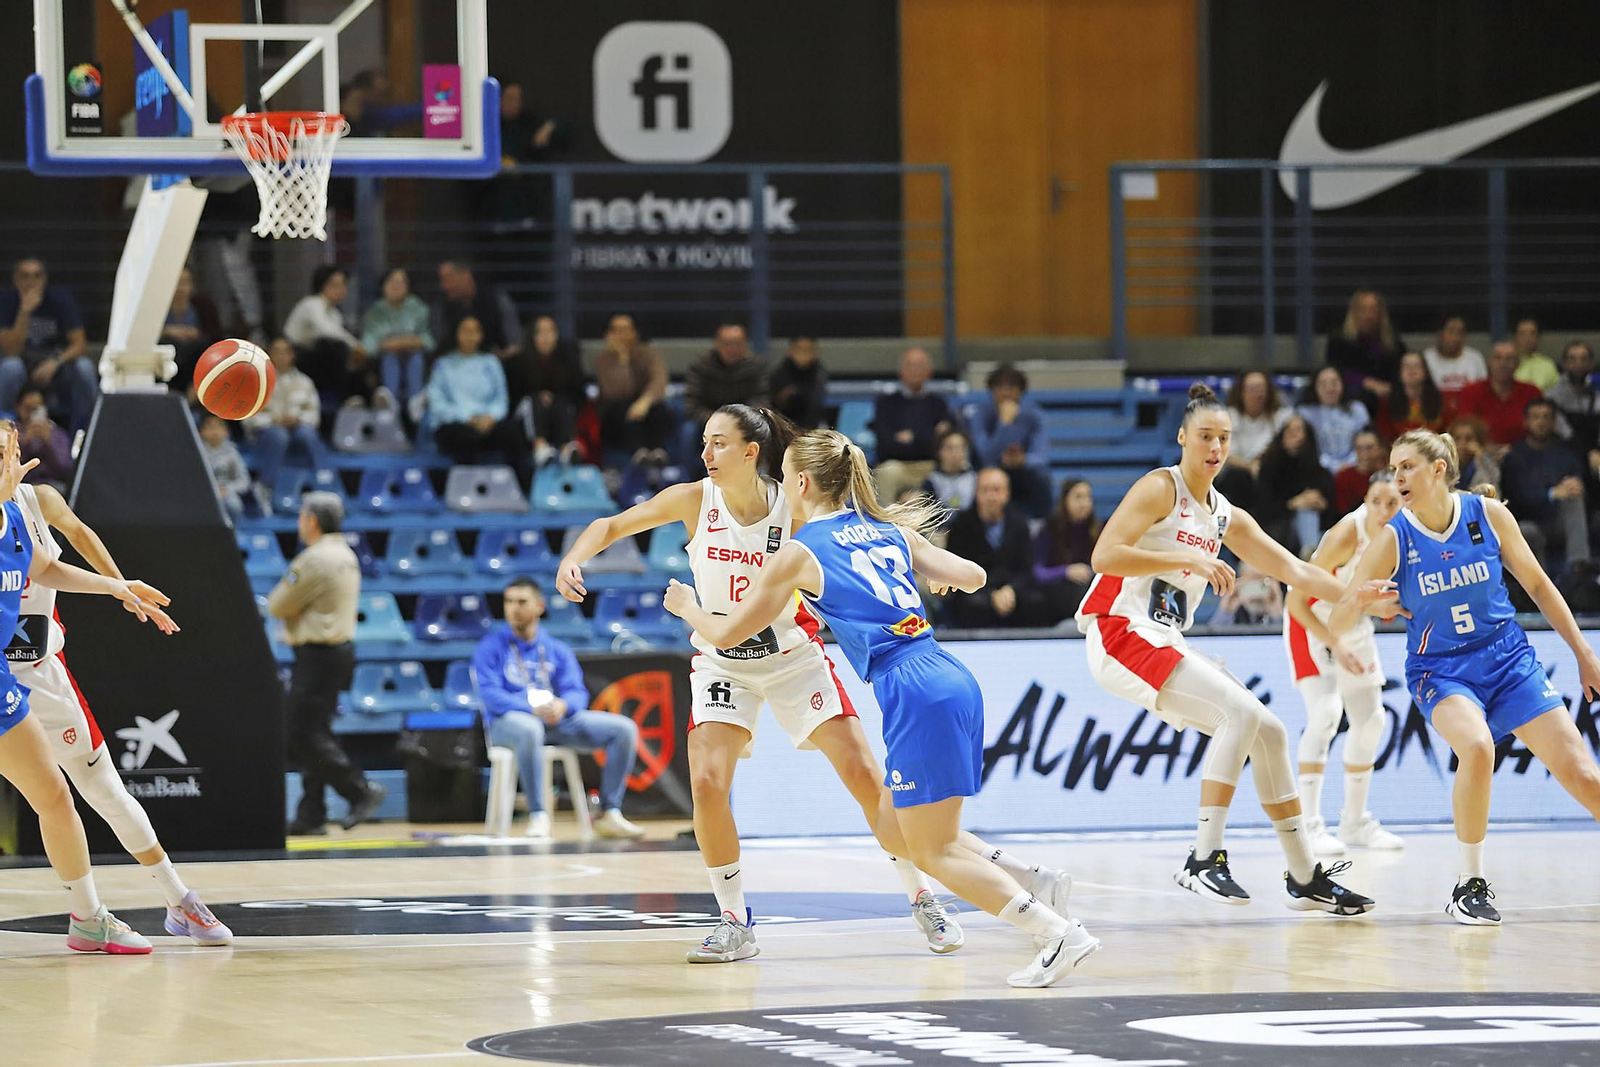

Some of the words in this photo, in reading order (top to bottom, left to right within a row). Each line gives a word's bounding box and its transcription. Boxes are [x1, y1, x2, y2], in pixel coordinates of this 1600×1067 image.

[707, 546, 765, 568] ESPAÑ
[729, 574, 751, 602] 12
[849, 545, 921, 609] 13
[1417, 561, 1491, 597] ÍSLAND
[1450, 603, 1476, 635] 5
[705, 701, 738, 711] network
